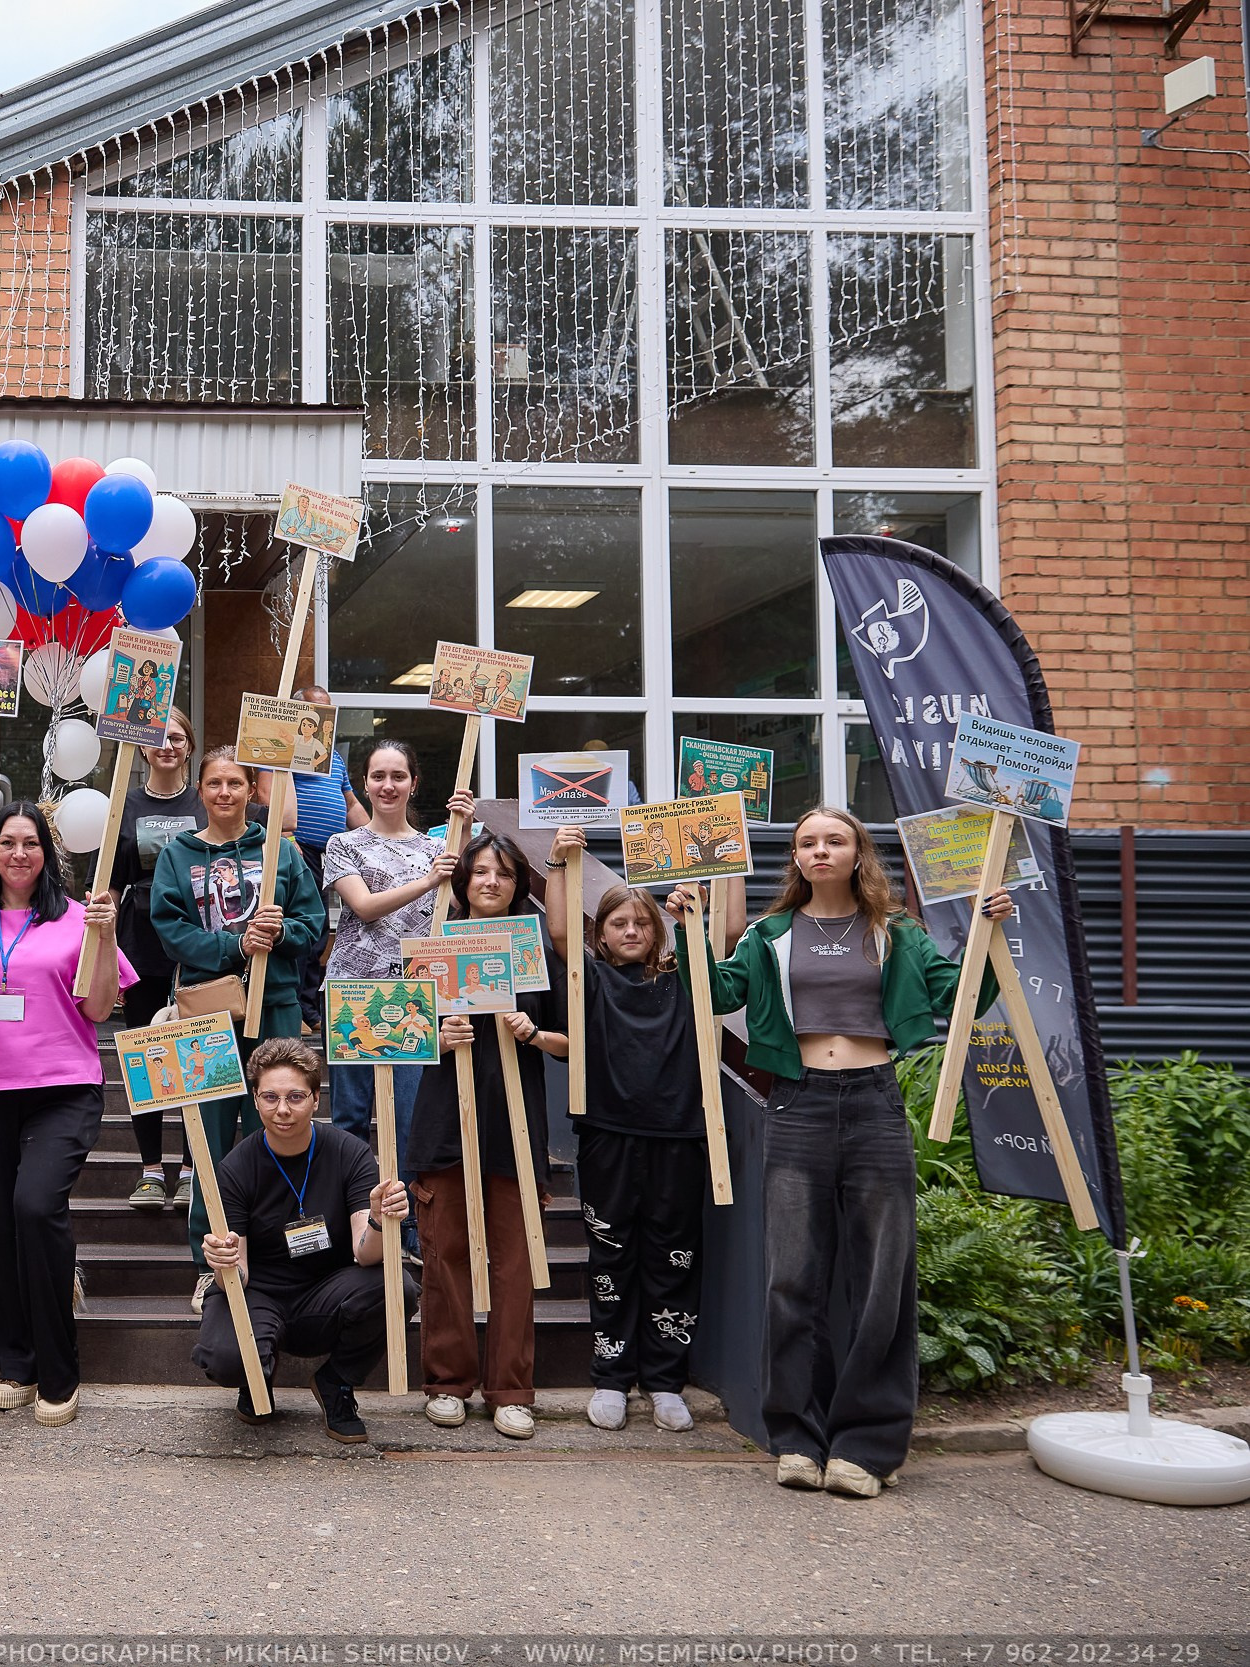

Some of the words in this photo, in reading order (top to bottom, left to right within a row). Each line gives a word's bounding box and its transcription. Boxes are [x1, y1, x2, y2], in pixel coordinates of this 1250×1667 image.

[289, 484, 302, 492] КУРС
[119, 633, 134, 641] ЕСЛИ
[140, 637, 159, 647] НУЖНА
[132, 643, 147, 651] МЕНЯ
[153, 647, 172, 656] КЛУБЕ!
[463, 648, 486, 657] ОВСЯНКУ
[272, 714, 298, 722] ПРОСИТСЯ!
[971, 720, 1016, 740] Видишь
[1019, 734, 1066, 754] человек
[686, 741, 737, 755] СКАНДИНАВСКАЯ
[738, 749, 760, 759] ХОДЬБА
[959, 733, 1012, 754] отдыхает
[1024, 750, 1073, 771] подойди
[720, 754, 745, 763] ПОМОГАЕТ
[996, 755, 1040, 774] Помоги
[145, 820, 185, 829] SKILLET
[927, 823, 959, 836] После
[963, 817, 991, 828] отдых
[944, 837, 950, 845] в
[953, 830, 986, 843] Египте
[926, 844, 982, 861] приезжайте
[450, 924, 480, 932] ФОНТАН
[410, 947, 452, 955] ШАМПАНСКОГО
[143, 1030, 160, 1038] душа
[160, 1024, 182, 1033] Шарко
[190, 1018, 218, 1027] порхаю,
[146, 1032, 183, 1043] Жар-птица
[191, 1026, 212, 1034] легко!
